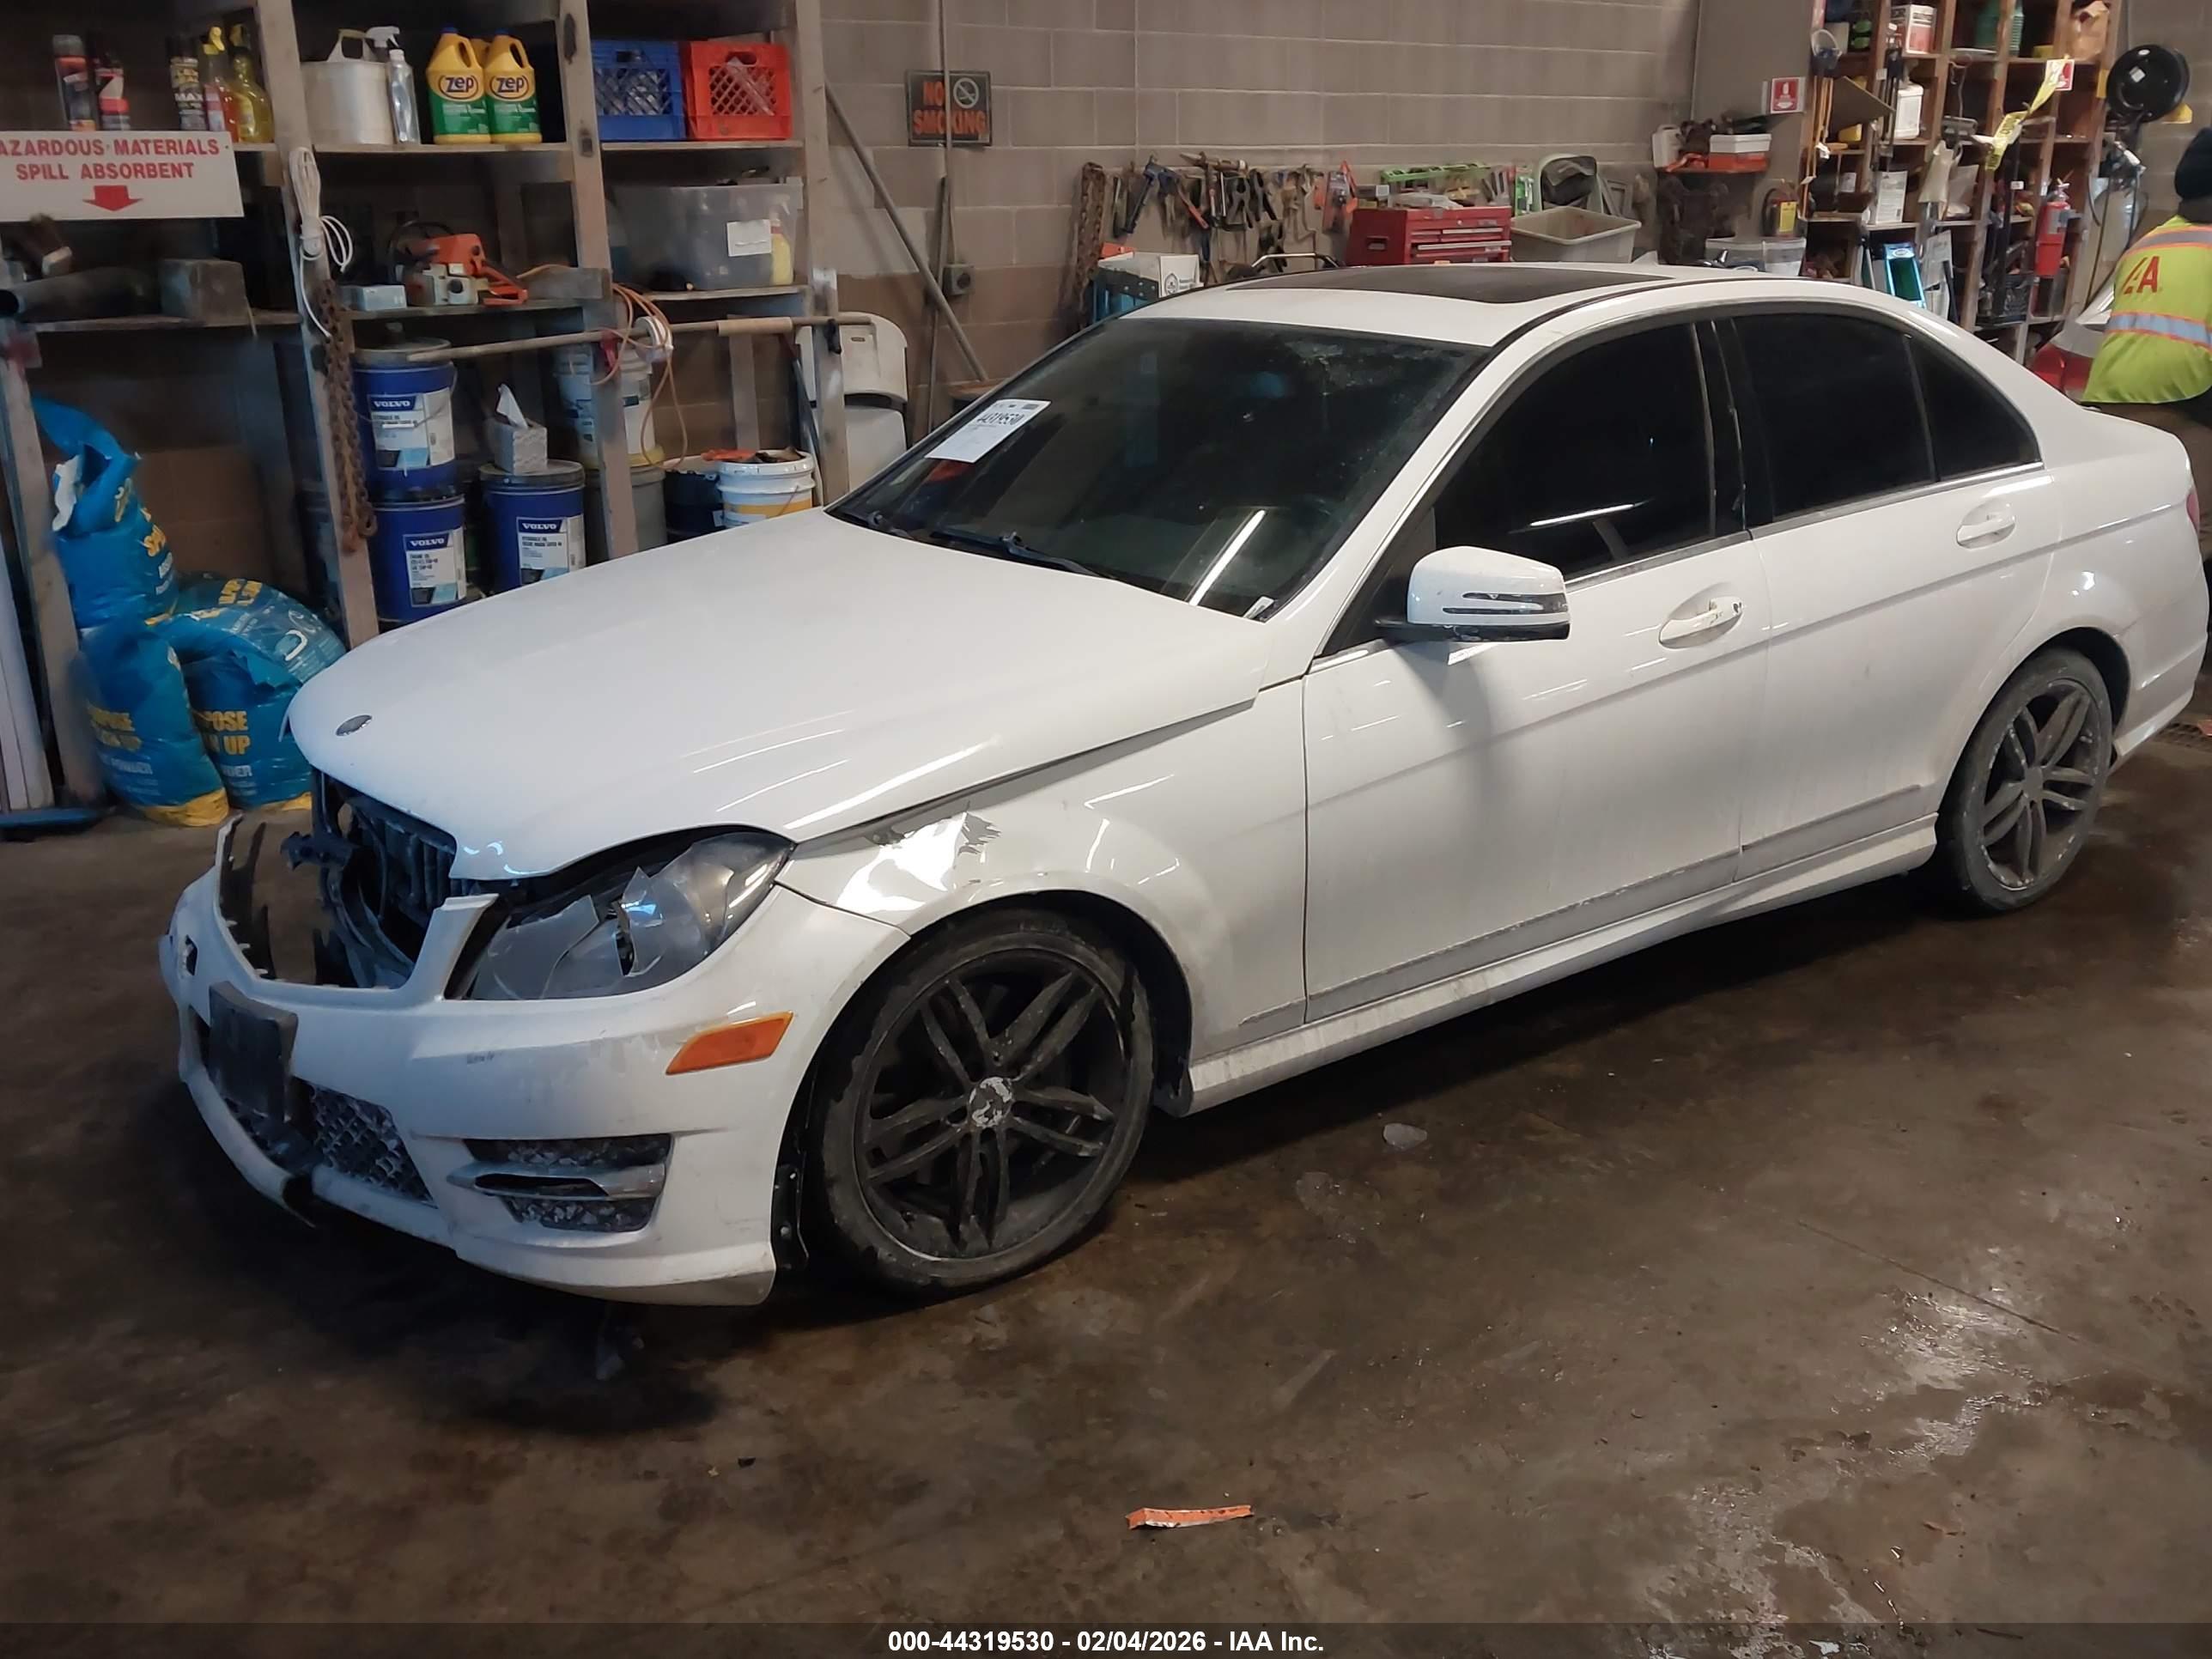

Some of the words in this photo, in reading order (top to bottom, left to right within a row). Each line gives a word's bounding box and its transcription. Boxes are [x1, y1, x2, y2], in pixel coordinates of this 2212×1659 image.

[923, 81, 945, 106] NO
[113, 139, 220, 155] MATERIALS
[15, 163, 70, 180] SPILL
[81, 162, 194, 179] ABSORBENT
[410, 538, 445, 547] VOLVO
[222, 735, 251, 755] UP
